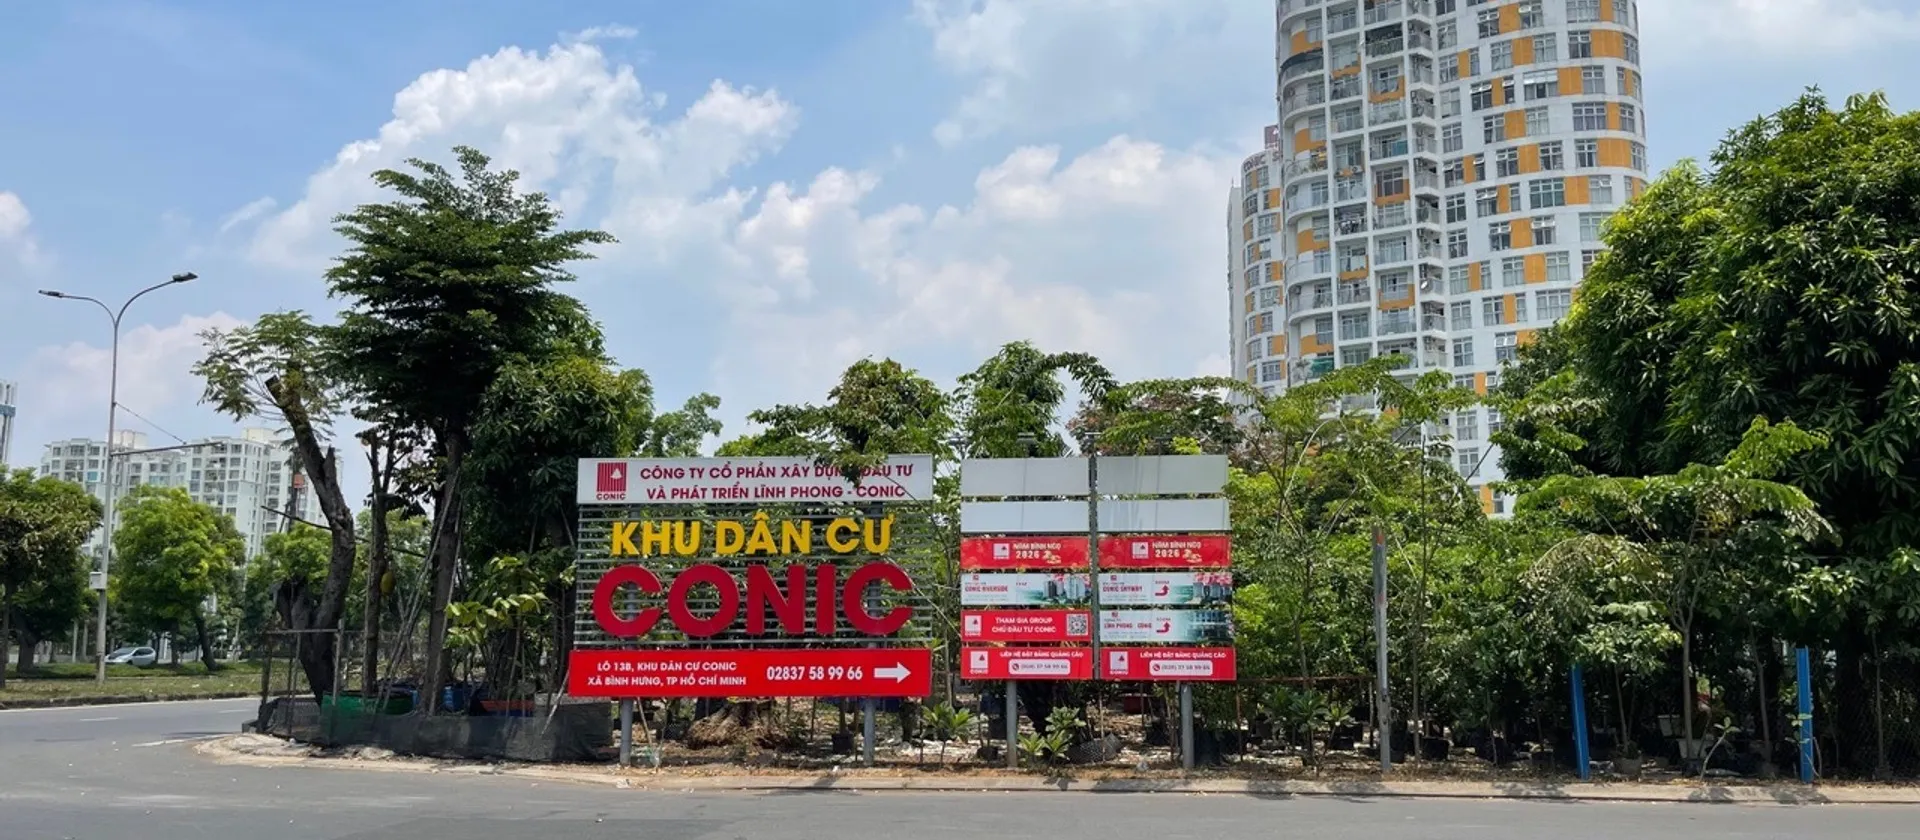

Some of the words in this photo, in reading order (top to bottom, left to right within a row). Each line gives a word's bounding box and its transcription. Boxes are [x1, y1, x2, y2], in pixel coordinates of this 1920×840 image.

[640, 465, 685, 480] CÔNG
[689, 467, 705, 479] TY
[709, 460, 732, 479] CỔ
[781, 463, 810, 478] XÂY
[814, 464, 848, 480] DỰN
[896, 463, 914, 477] TƯ
[596, 493, 626, 501] CONIC
[647, 485, 666, 500] VÀ
[671, 484, 708, 499] PHÁT
[711, 480, 749, 499] TRIỂN
[754, 484, 786, 498] LĨNH
[790, 485, 843, 498] PHONG
[856, 485, 906, 498] CONIC
[612, 520, 701, 556] KHU
[715, 512, 812, 556] DÂN
[825, 513, 897, 555] CƯ
[1015, 550, 1040, 559] 2026
[1155, 549, 1180, 558] 2026
[592, 561, 914, 638] CONIC
[1024, 625, 1034, 633] TƯ
[1034, 625, 1057, 633] CONIC
[597, 660, 611, 671] LÔ
[614, 662, 634, 673] 13B,
[637, 662, 658, 671] KHU
[660, 660, 682, 671] DÂN
[685, 661, 700, 671] CƯ
[702, 661, 737, 671] CONIC
[766, 666, 805, 680] 02837
[809, 666, 824, 680] 58
[828, 666, 844, 680] 99
[847, 666, 863, 680] 66
[588, 675, 602, 685] XÃ
[605, 675, 629, 685] BÌNH
[631, 675, 664, 687] HƯNG,
[666, 676, 678, 685] TP
[680, 673, 696, 685] HỒ
[698, 674, 717, 685] CHÍ
[720, 676, 746, 685] MINH
